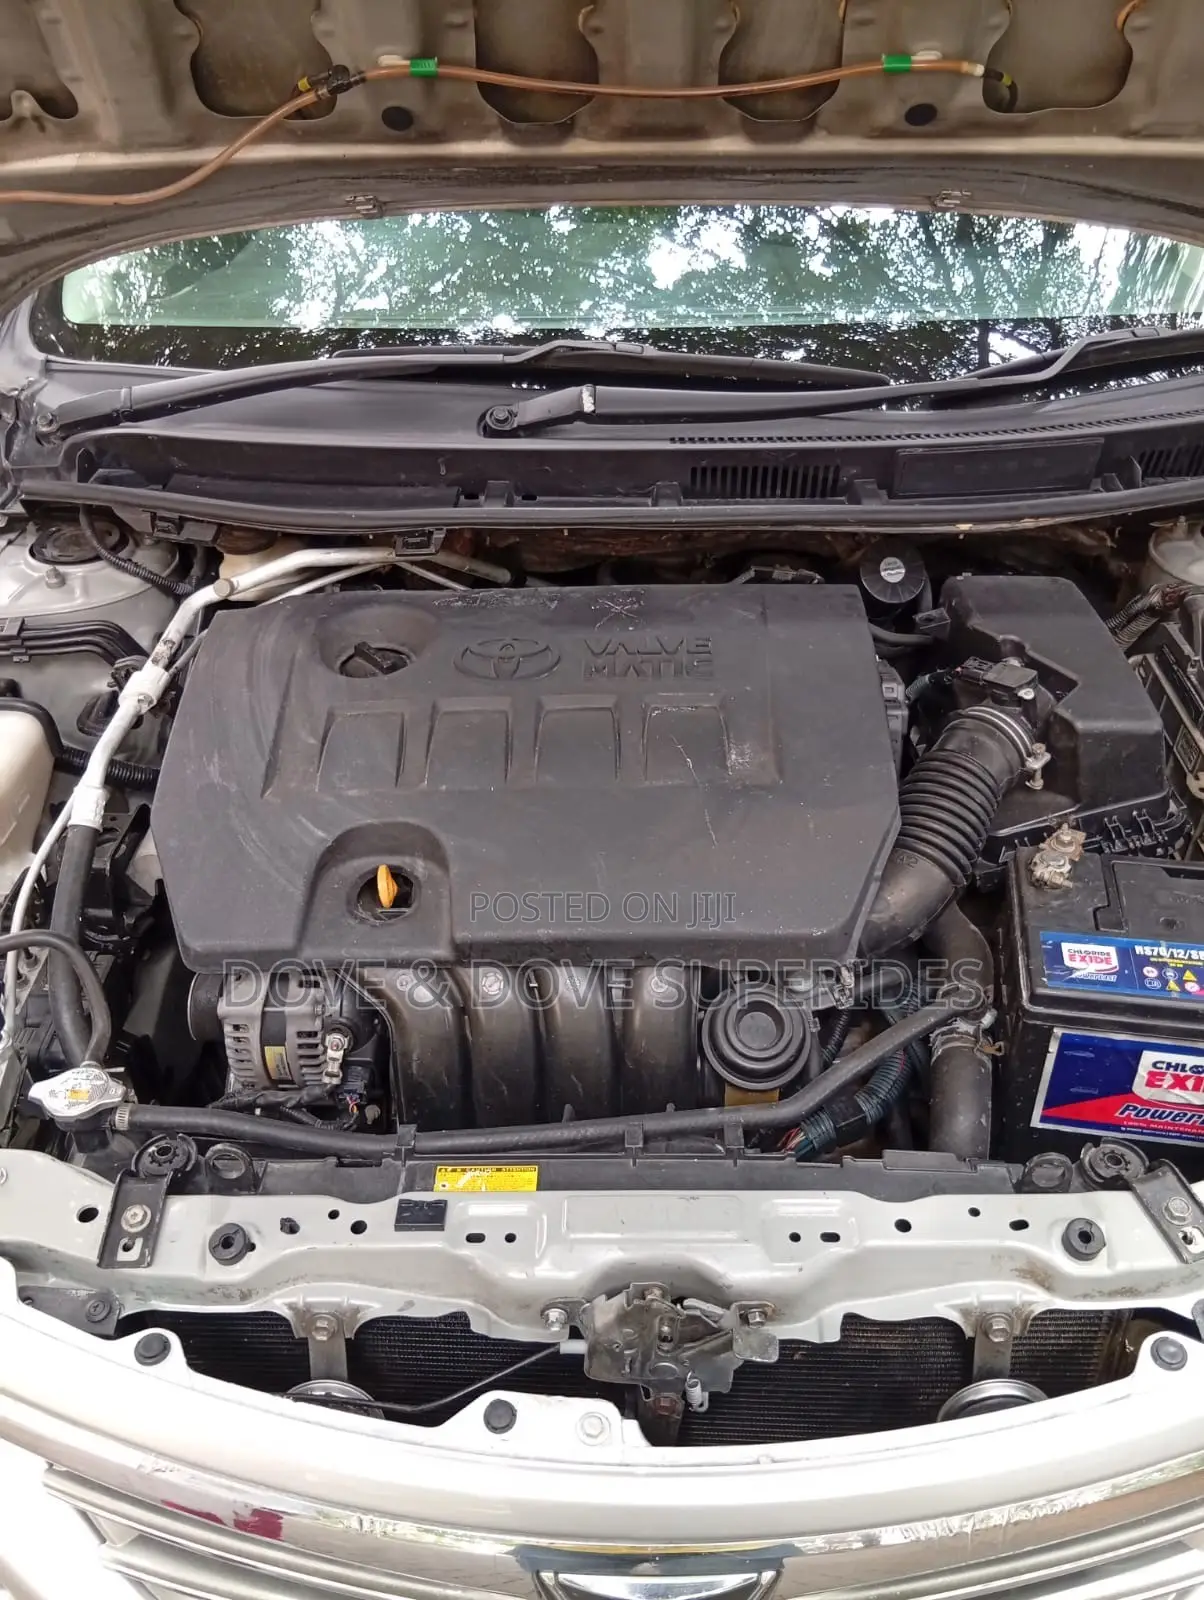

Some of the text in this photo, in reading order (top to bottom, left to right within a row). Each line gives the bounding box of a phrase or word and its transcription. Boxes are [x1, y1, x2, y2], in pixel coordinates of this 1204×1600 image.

[583, 636, 713, 656] VALVE
[582, 656, 714, 679] MATIC
[1067, 948, 1111, 957] CHLORIDE
[1068, 953, 1113, 966] EXIDE
[1144, 1070, 1204, 1094] EXI
[1114, 1103, 1204, 1127] Power
